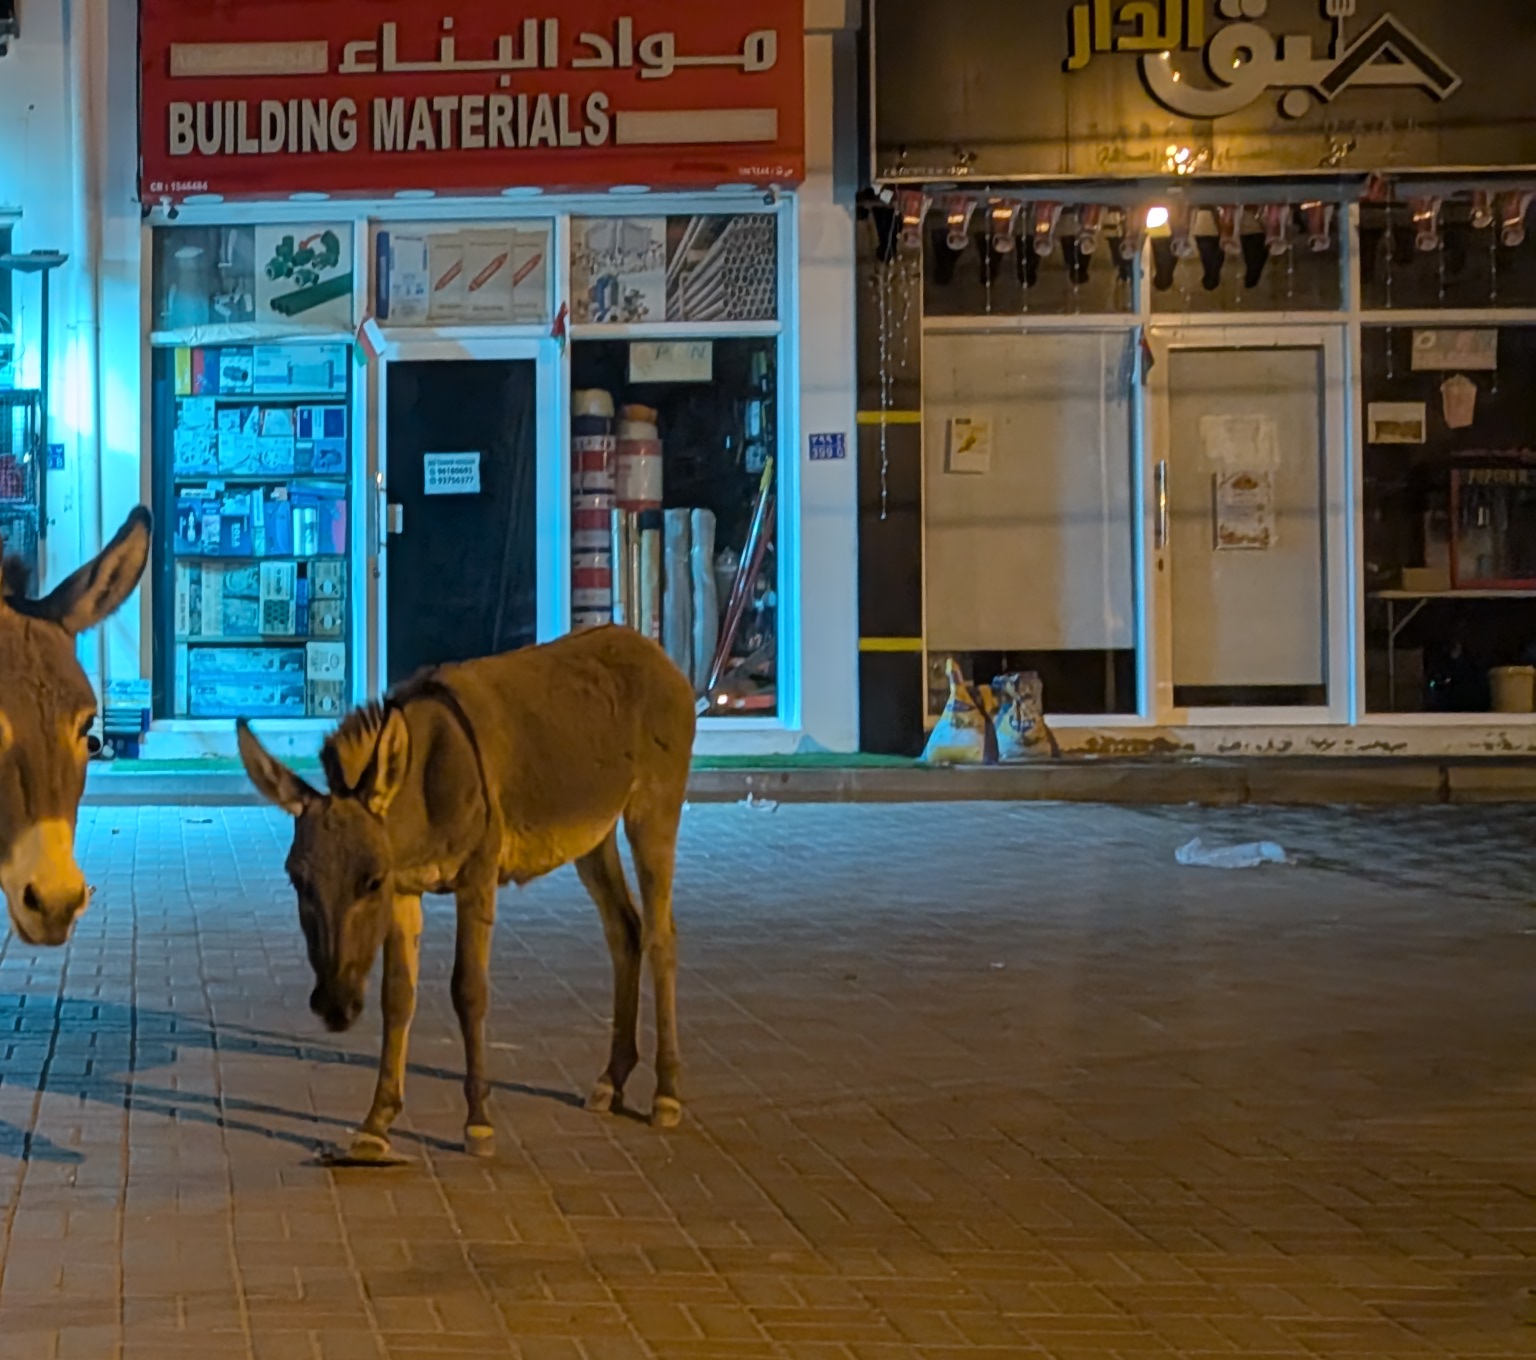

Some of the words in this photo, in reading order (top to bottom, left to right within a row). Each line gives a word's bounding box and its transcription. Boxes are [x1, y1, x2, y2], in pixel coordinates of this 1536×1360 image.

[339, 16, 559, 88] البناء
[571, 15, 778, 80] مواد
[169, 97, 357, 156] BUILDING
[373, 91, 610, 152] MATERIALS
